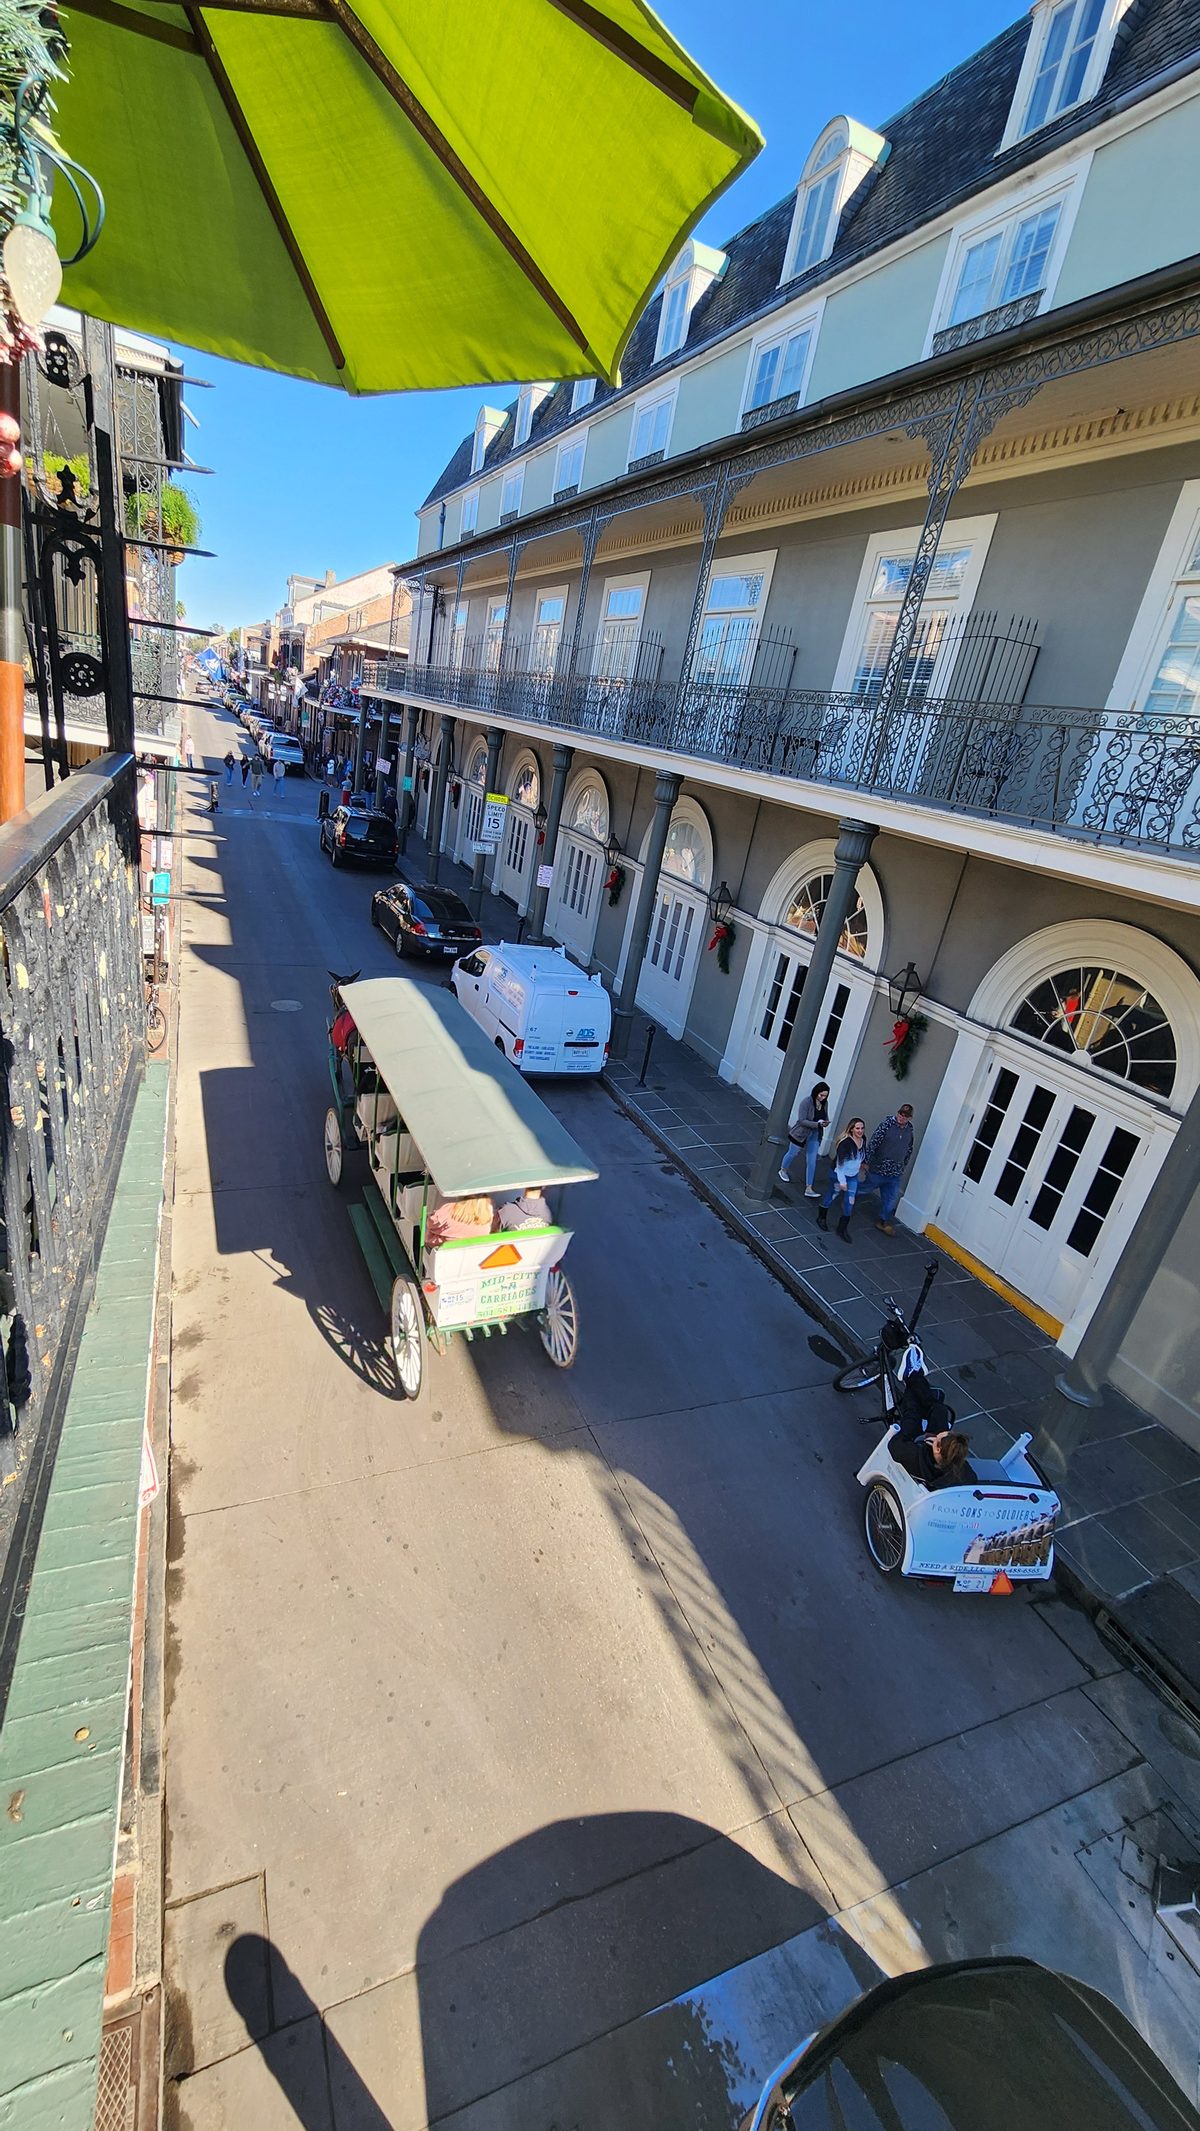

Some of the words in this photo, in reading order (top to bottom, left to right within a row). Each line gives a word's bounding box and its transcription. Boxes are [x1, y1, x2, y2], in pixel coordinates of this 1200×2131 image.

[487, 794, 507, 803] SCHOOL
[487, 817, 500, 829] 15
[481, 1271, 541, 1289] MID-CITY
[480, 1286, 538, 1305] CARRIAGES
[931, 1503, 958, 1514] FROM
[960, 1506, 983, 1518] SONS
[995, 1509, 1035, 1521] SOLDIERS
